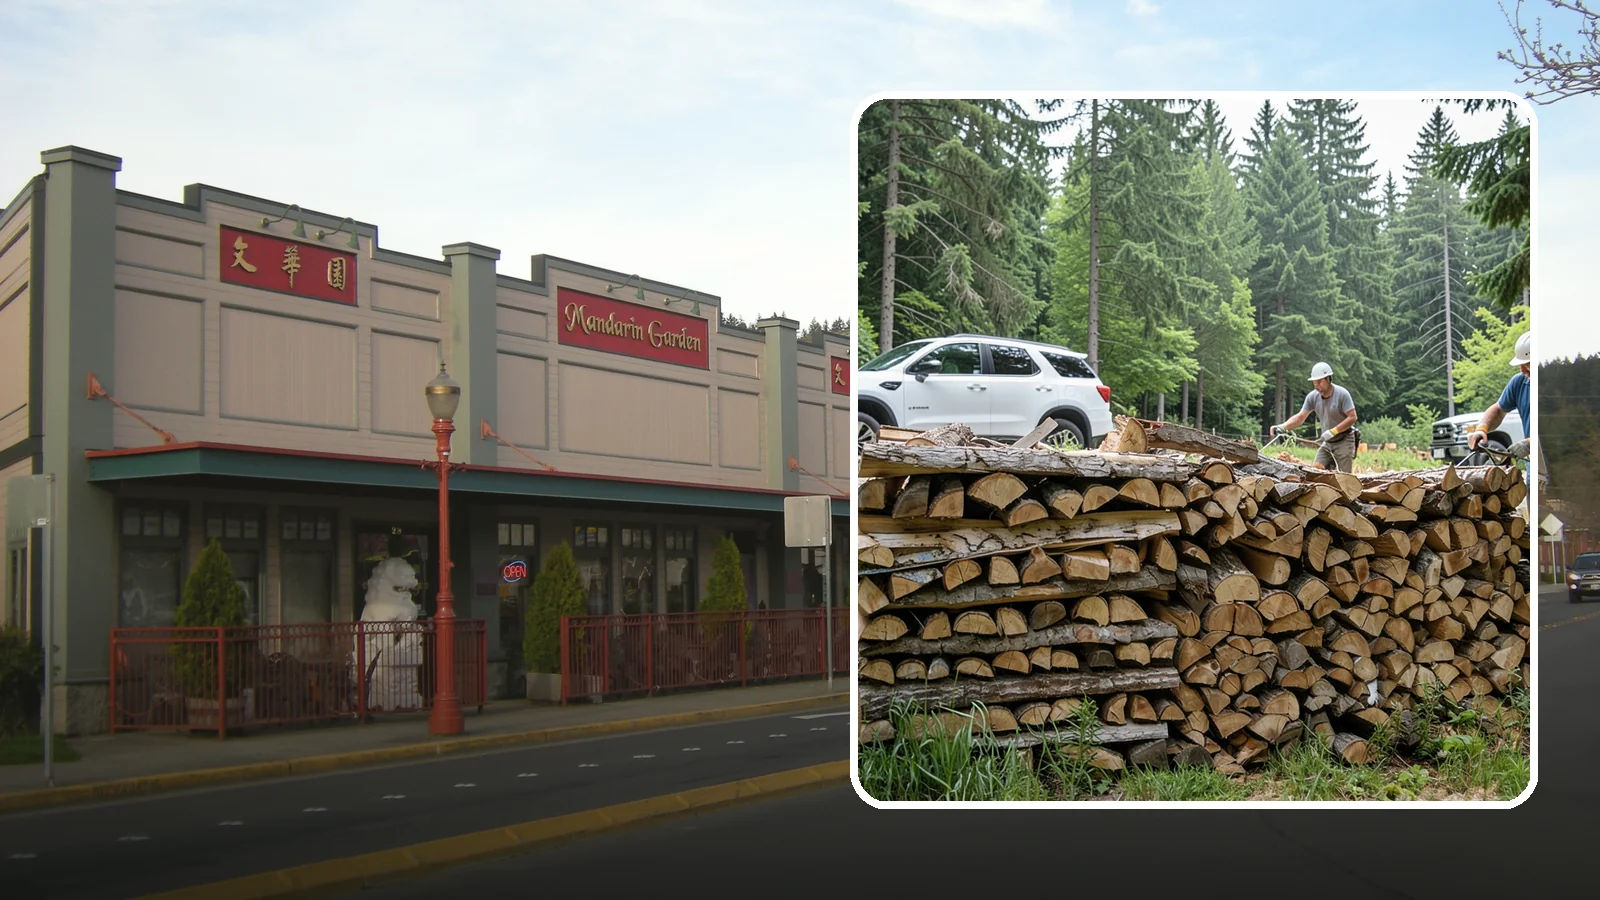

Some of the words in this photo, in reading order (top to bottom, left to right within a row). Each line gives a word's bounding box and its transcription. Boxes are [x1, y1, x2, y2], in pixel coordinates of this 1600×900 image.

[230, 236, 346, 291] 文華園
[564, 302, 644, 341] Mandarin
[647, 320, 702, 352] Garden
[503, 565, 527, 578] OPEN
